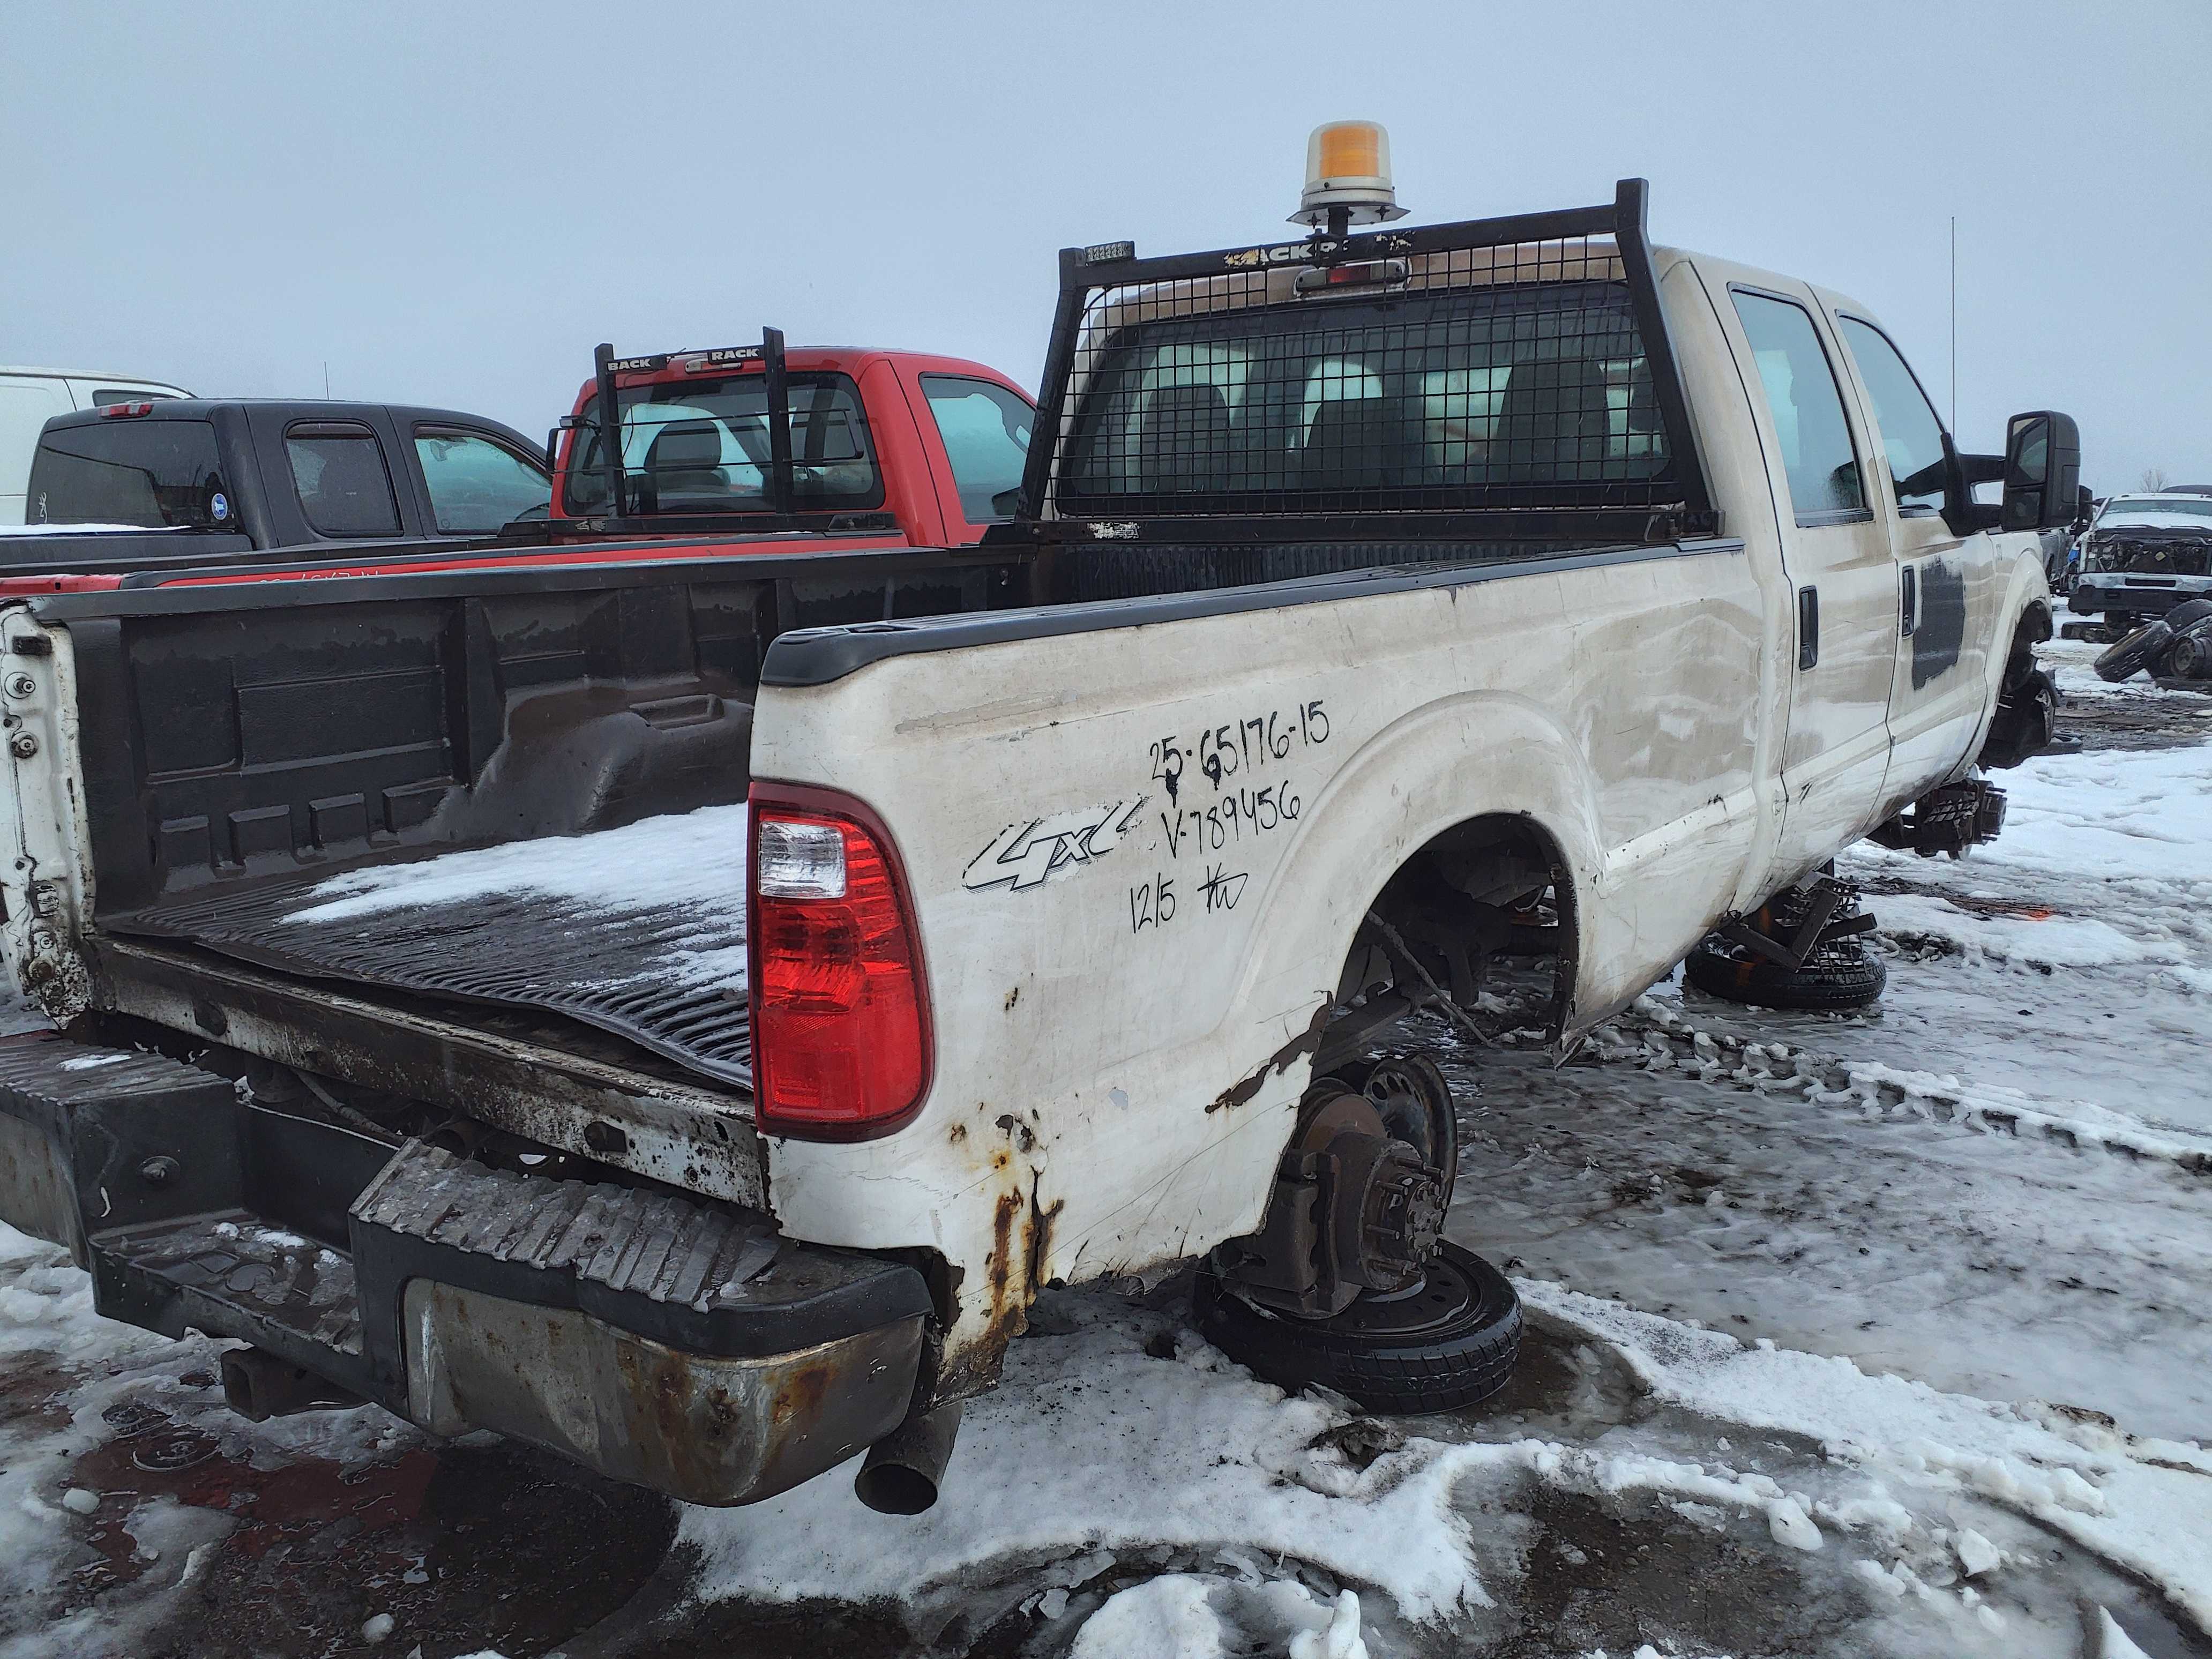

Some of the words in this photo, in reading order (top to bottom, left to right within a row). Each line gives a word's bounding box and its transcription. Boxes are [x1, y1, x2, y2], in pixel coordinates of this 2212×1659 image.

[1246, 244, 1314, 264] ACK
[607, 358, 651, 371] BACK
[711, 348, 758, 361] RACK
